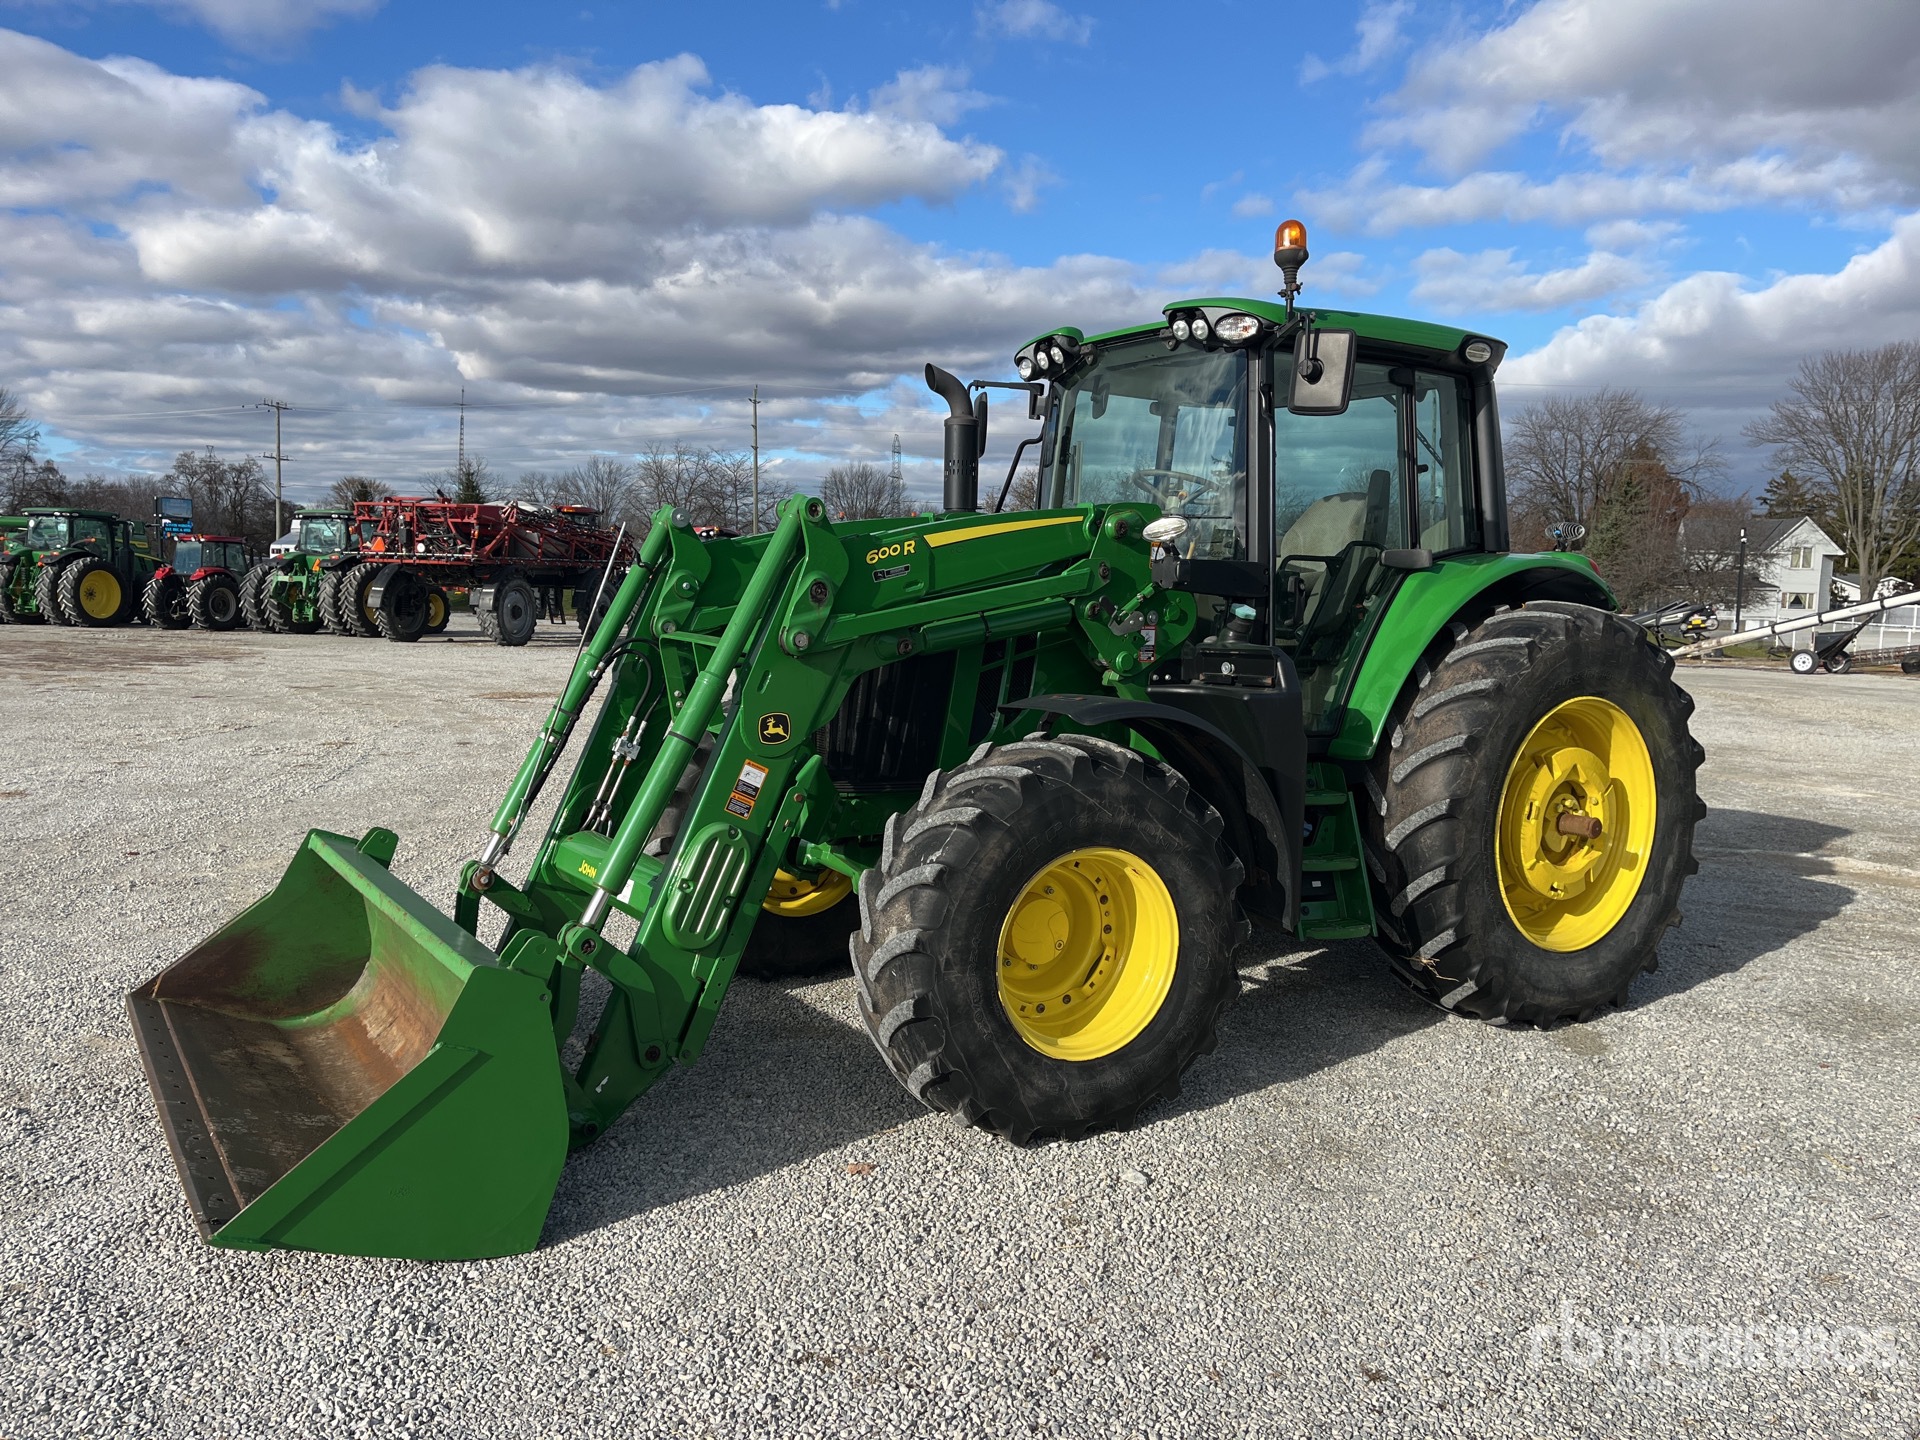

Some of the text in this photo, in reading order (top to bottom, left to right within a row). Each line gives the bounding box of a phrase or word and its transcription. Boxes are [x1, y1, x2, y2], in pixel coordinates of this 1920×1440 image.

[866, 540, 916, 564] 600 R
[578, 860, 597, 879] JOHN
